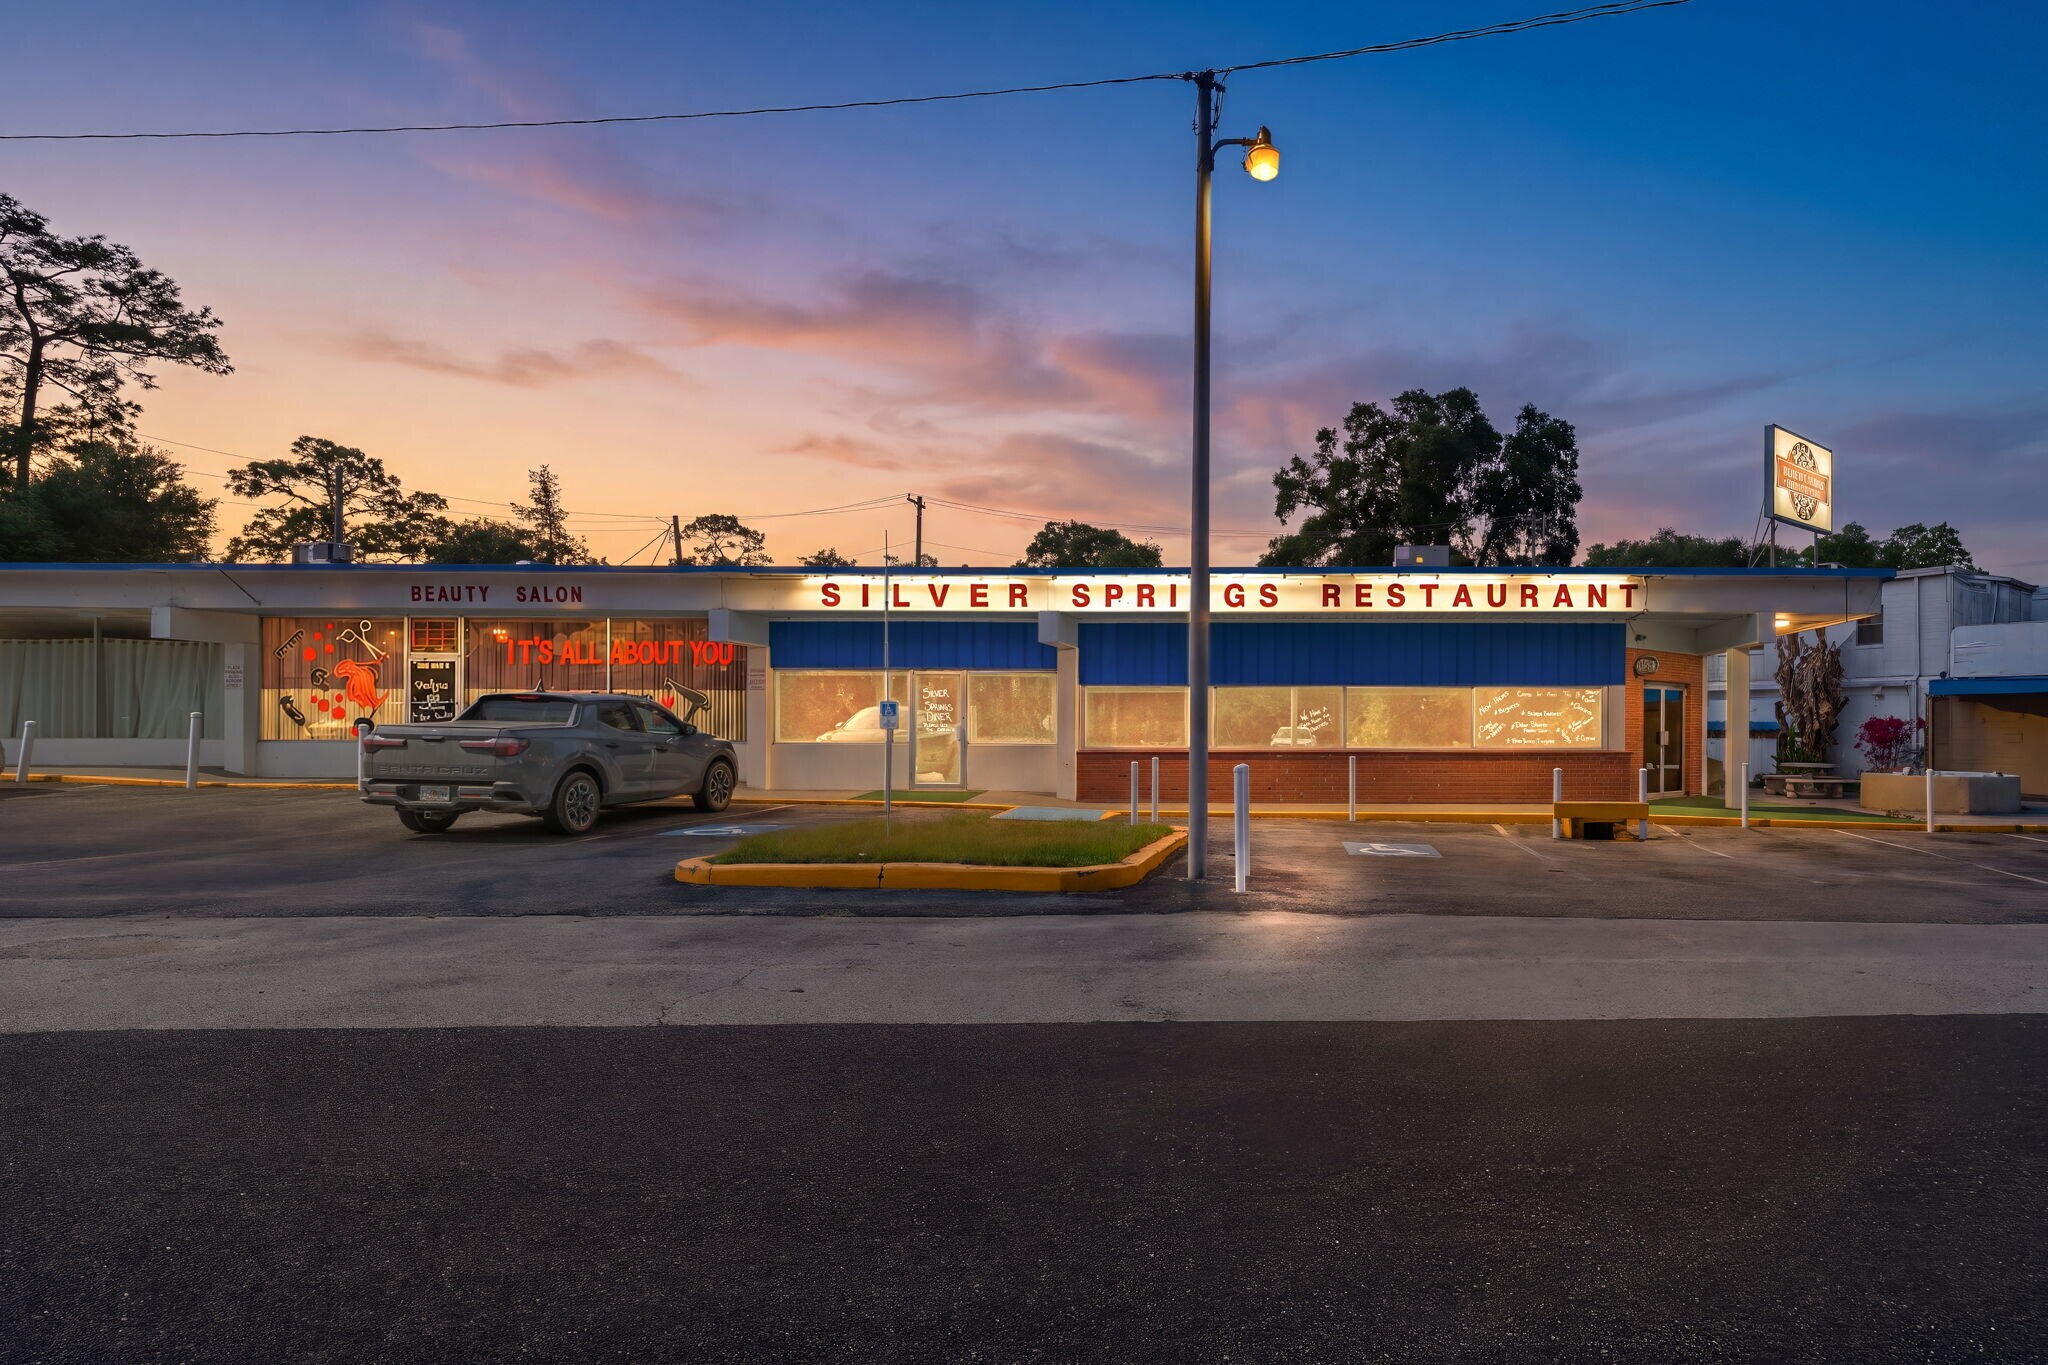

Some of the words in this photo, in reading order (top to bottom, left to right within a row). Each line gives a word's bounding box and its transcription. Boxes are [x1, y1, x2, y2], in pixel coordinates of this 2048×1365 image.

[411, 586, 490, 602] BEAUTY
[516, 586, 583, 603] SALON
[821, 583, 1029, 608] SILVER
[1072, 583, 1279, 608] SPRIGS
[1322, 583, 1638, 608] RESTAURANT
[507, 636, 553, 665] IT'S
[559, 640, 604, 665] ALL
[610, 639, 684, 665] ABOUT
[689, 640, 734, 666] YOU
[438, 766, 490, 776] CRUZ
